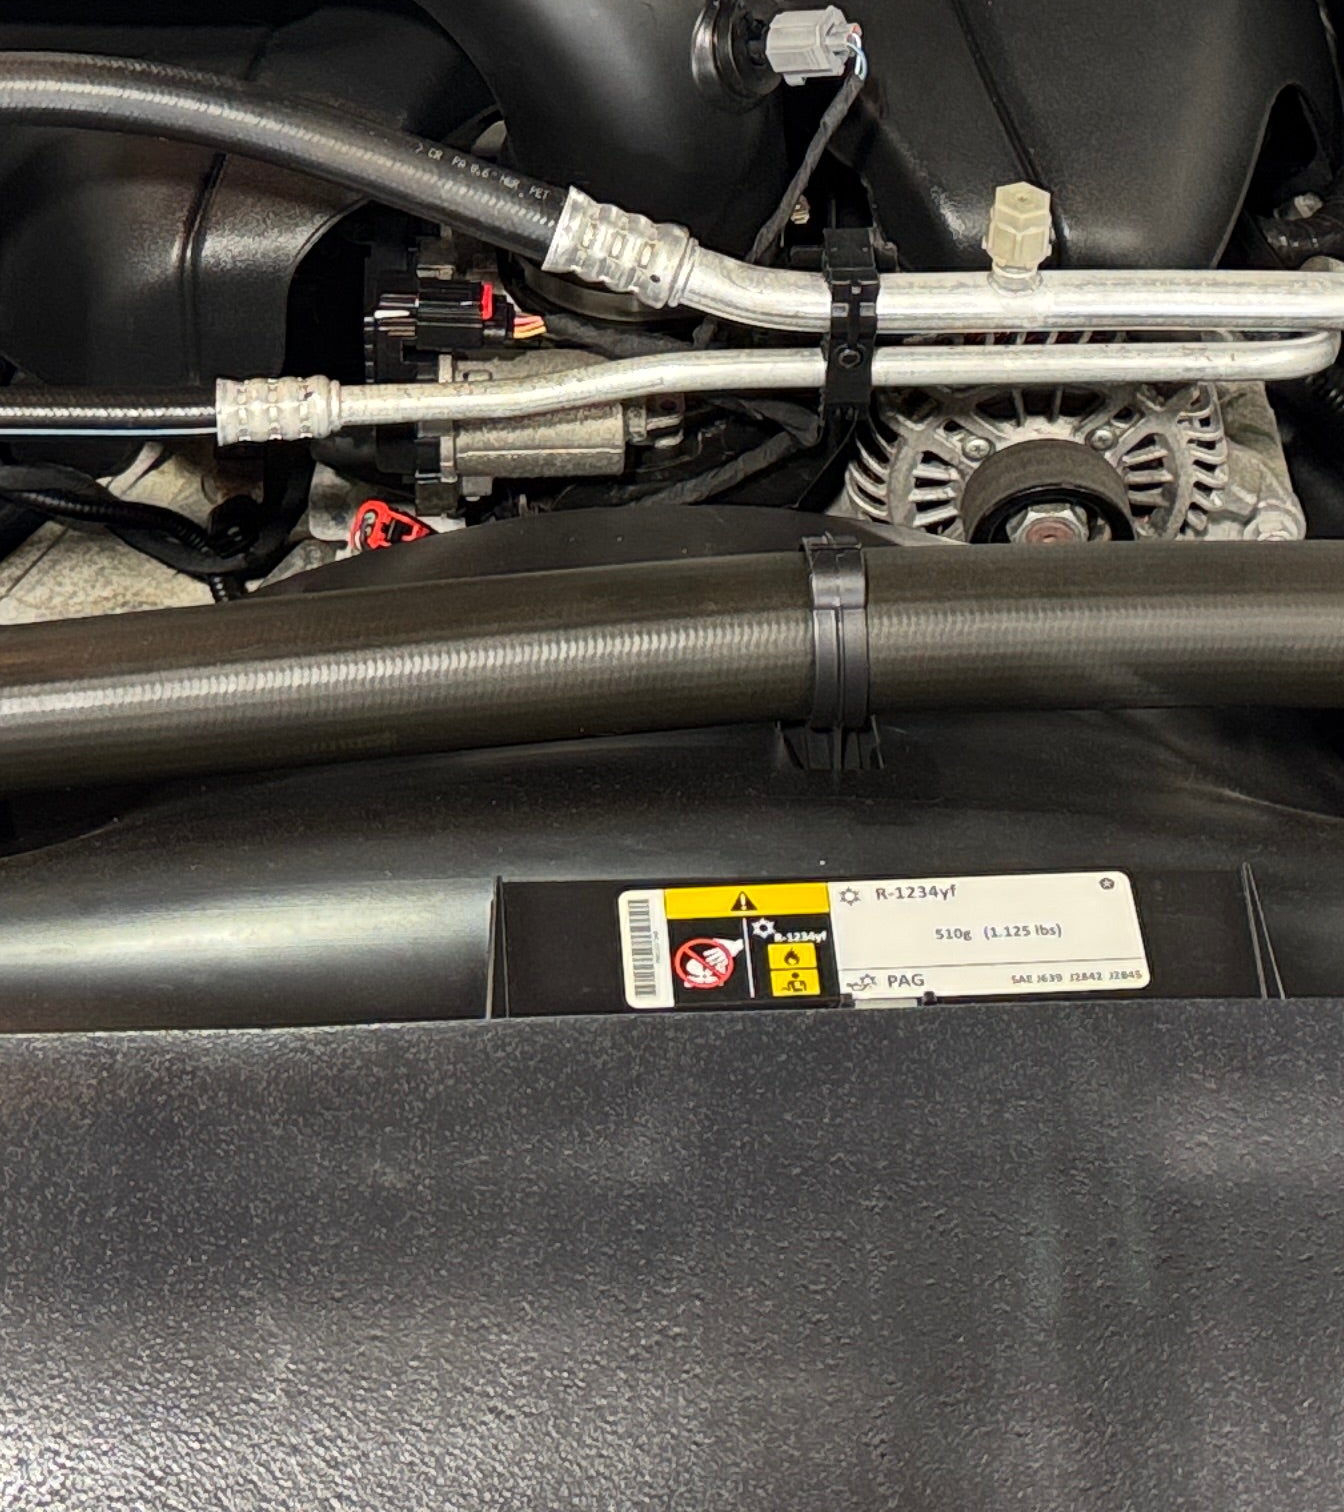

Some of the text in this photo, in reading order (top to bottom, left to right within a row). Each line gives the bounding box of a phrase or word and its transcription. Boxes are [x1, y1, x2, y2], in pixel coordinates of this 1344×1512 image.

[528, 185, 551, 200] PET
[875, 883, 957, 901] R-1234yf
[773, 930, 828, 944] R-1234yf
[935, 923, 1063, 941] 510g (1.125 lbs)
[887, 973, 926, 988] PAG
[1011, 974, 1033, 984] SAE
[1036, 972, 1063, 983] J639
[1069, 971, 1104, 982] J2842
